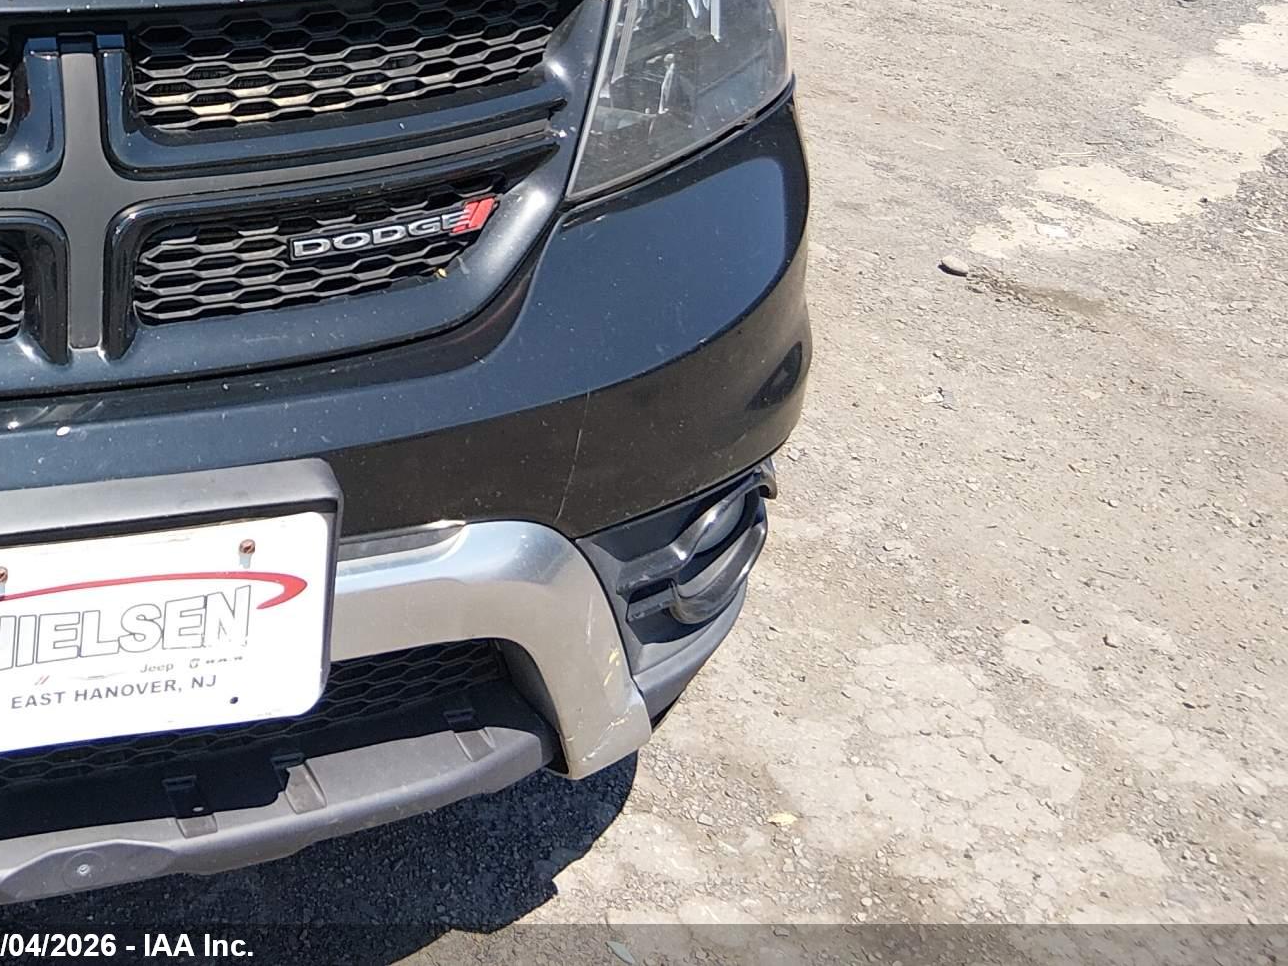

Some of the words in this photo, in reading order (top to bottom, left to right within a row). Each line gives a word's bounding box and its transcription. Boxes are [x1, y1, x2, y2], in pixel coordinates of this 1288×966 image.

[293, 208, 472, 257] DODGE
[11, 690, 66, 710] EAST
[74, 679, 183, 702] HANOVER,
[191, 674, 217, 690] NJ
